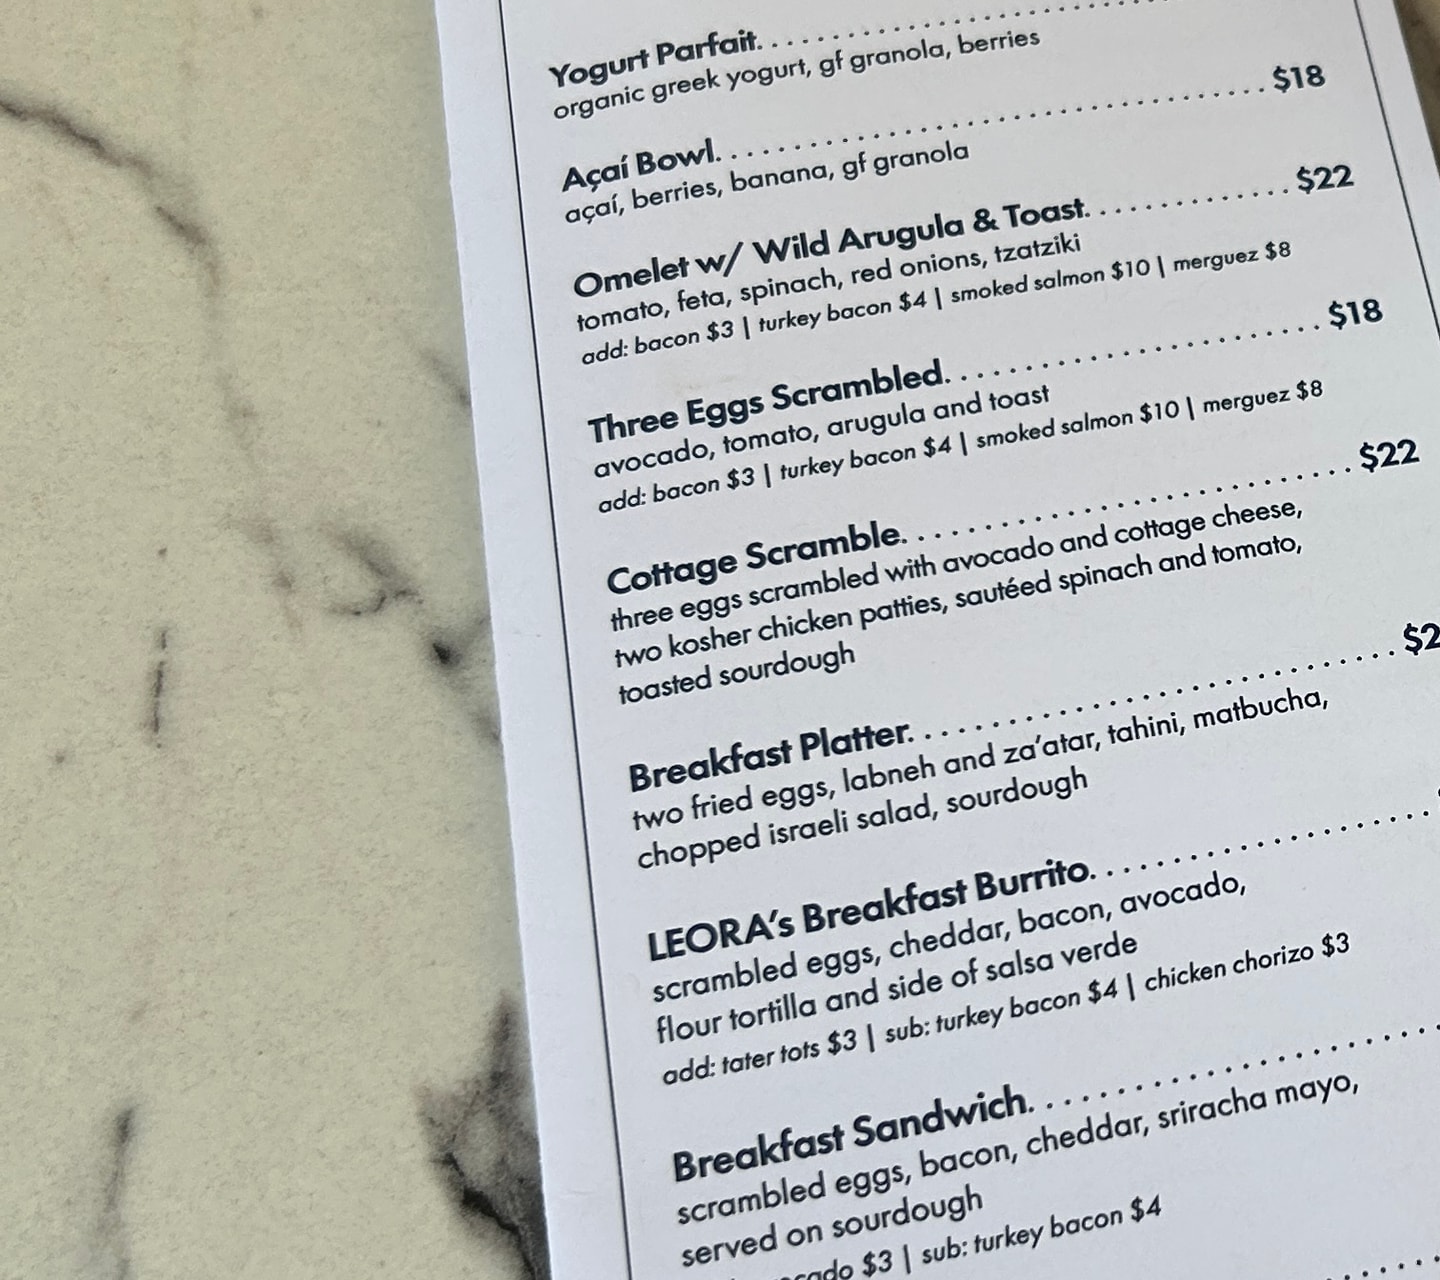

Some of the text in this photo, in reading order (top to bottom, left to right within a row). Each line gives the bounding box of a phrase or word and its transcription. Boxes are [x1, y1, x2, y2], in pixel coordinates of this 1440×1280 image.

[547, 48, 650, 89] Yogurt
[655, 28, 758, 66] Parfait
[553, 30, 1041, 120] organic greek yogurt, gf granola, berries
[561, 64, 1326, 193] Açaí Bowl $18
[564, 139, 970, 225] açaí, berries, banana, gf granola
[573, 164, 1355, 298] Omelet w/ Wild Arugula & Toast $22
[581, 240, 1291, 366] add: bacon $3 turkey bacon $4 smoked salmon $10 merguez $8
[586, 298, 1384, 444] Three Eggs Scrambled $18
[606, 438, 1421, 595] Cottage Scramble $22
[610, 501, 1303, 633] three eggs scrambled with avocado and cottage cheese,
[628, 739, 793, 793] Breakfast
[799, 723, 910, 761] Platter
[631, 686, 1329, 831] two fried eggs, labneh and za'atar, tahini, matbucha,
[647, 908, 796, 962] LEORA's
[801, 879, 968, 934] Breakfast
[973, 858, 1090, 902] Burrito
[652, 869, 1246, 1003] scrambled eggs, cheddar, bacon, avocado,
[662, 931, 1350, 1086] add: tater tots $3 sub: turkey bacon $4 chicken chorizo $3
[672, 1124, 846, 1183] Breakfast
[852, 1083, 1028, 1148] Sandwich
[681, 1183, 983, 1268] served on sourdough
[861, 1249, 893, 1279] $3
[922, 1235, 968, 1265] sub:
[973, 1224, 1044, 1254] turkey
[1050, 1209, 1124, 1239] bacon
[1130, 1194, 1162, 1224] $4
